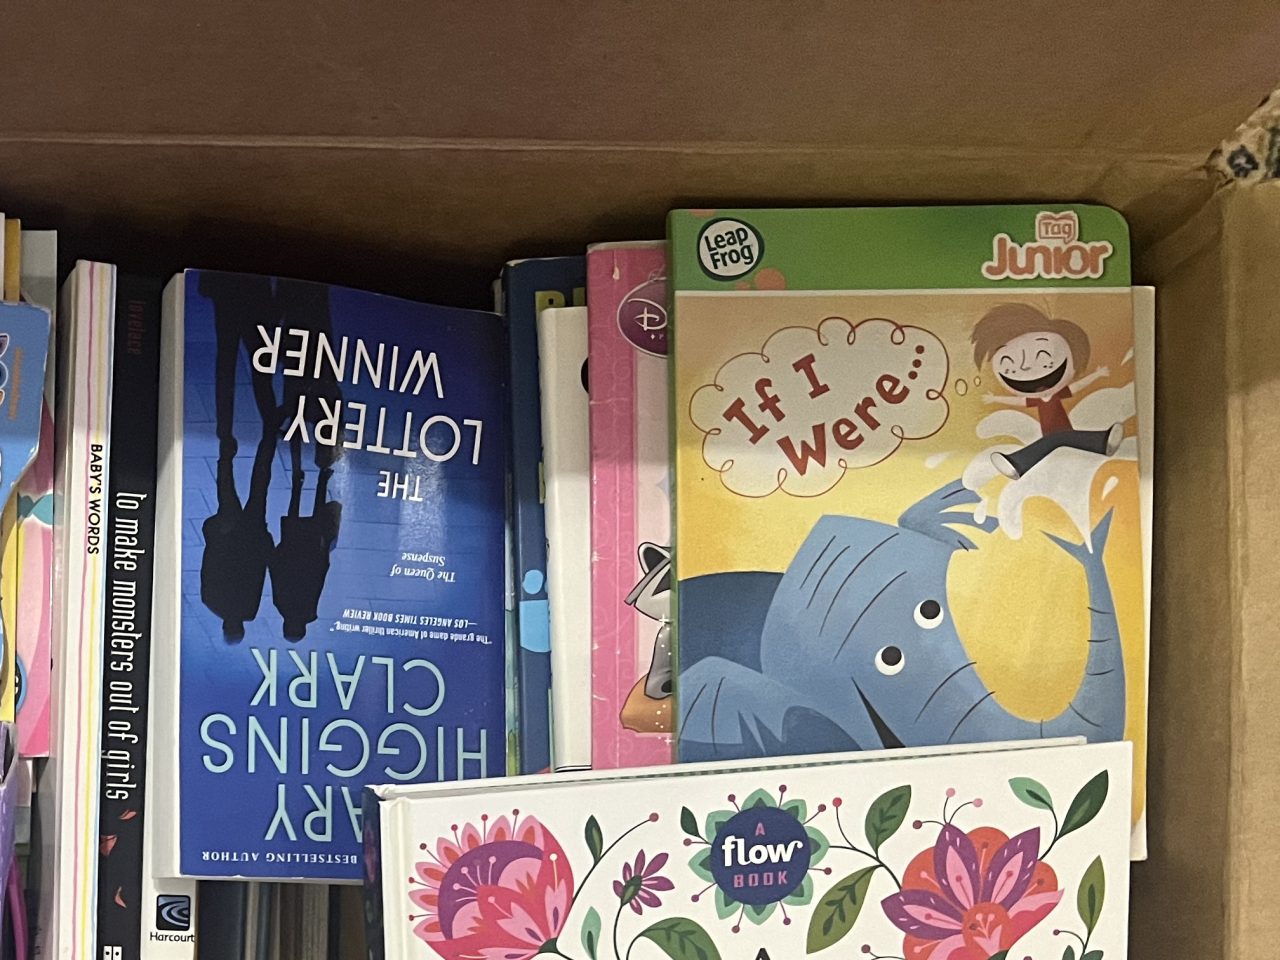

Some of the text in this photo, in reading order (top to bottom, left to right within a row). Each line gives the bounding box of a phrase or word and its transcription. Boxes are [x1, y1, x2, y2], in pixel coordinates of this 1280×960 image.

[704, 227, 748, 252] Leap
[1042, 222, 1072, 239] Tag
[710, 244, 754, 270] Frog
[984, 237, 1110, 276] Junior
[252, 325, 444, 398] WINNER
[722, 353, 830, 445] If I
[284, 395, 483, 465] LOTTERY
[377, 470, 424, 502] THE
[87, 444, 103, 555] BABY'S WORDS
[402, 552, 446, 567] Suspense
[389, 564, 456, 583] The Queen of
[342, 609, 371, 620] REVIEW
[373, 612, 393, 622] BOOK
[395, 614, 417, 625] TIMES
[420, 616, 452, 628] ANGELES
[362, 625, 385, 637] thriller
[387, 627, 419, 640] American
[429, 630, 449, 641] dame
[450, 631, 475, 643] grande
[102, 490, 147, 801] to make monsters out of girls
[250, 648, 445, 717] CLARK
[200, 713, 487, 781] HIGGINS
[265, 784, 363, 843] ARY
[755, 823, 766, 836] A
[201, 851, 357, 864] BESTSELLING AUTHOR
[721, 835, 804, 867] flow
[733, 870, 788, 888] BOOK
[149, 931, 196, 943] Harcourt
